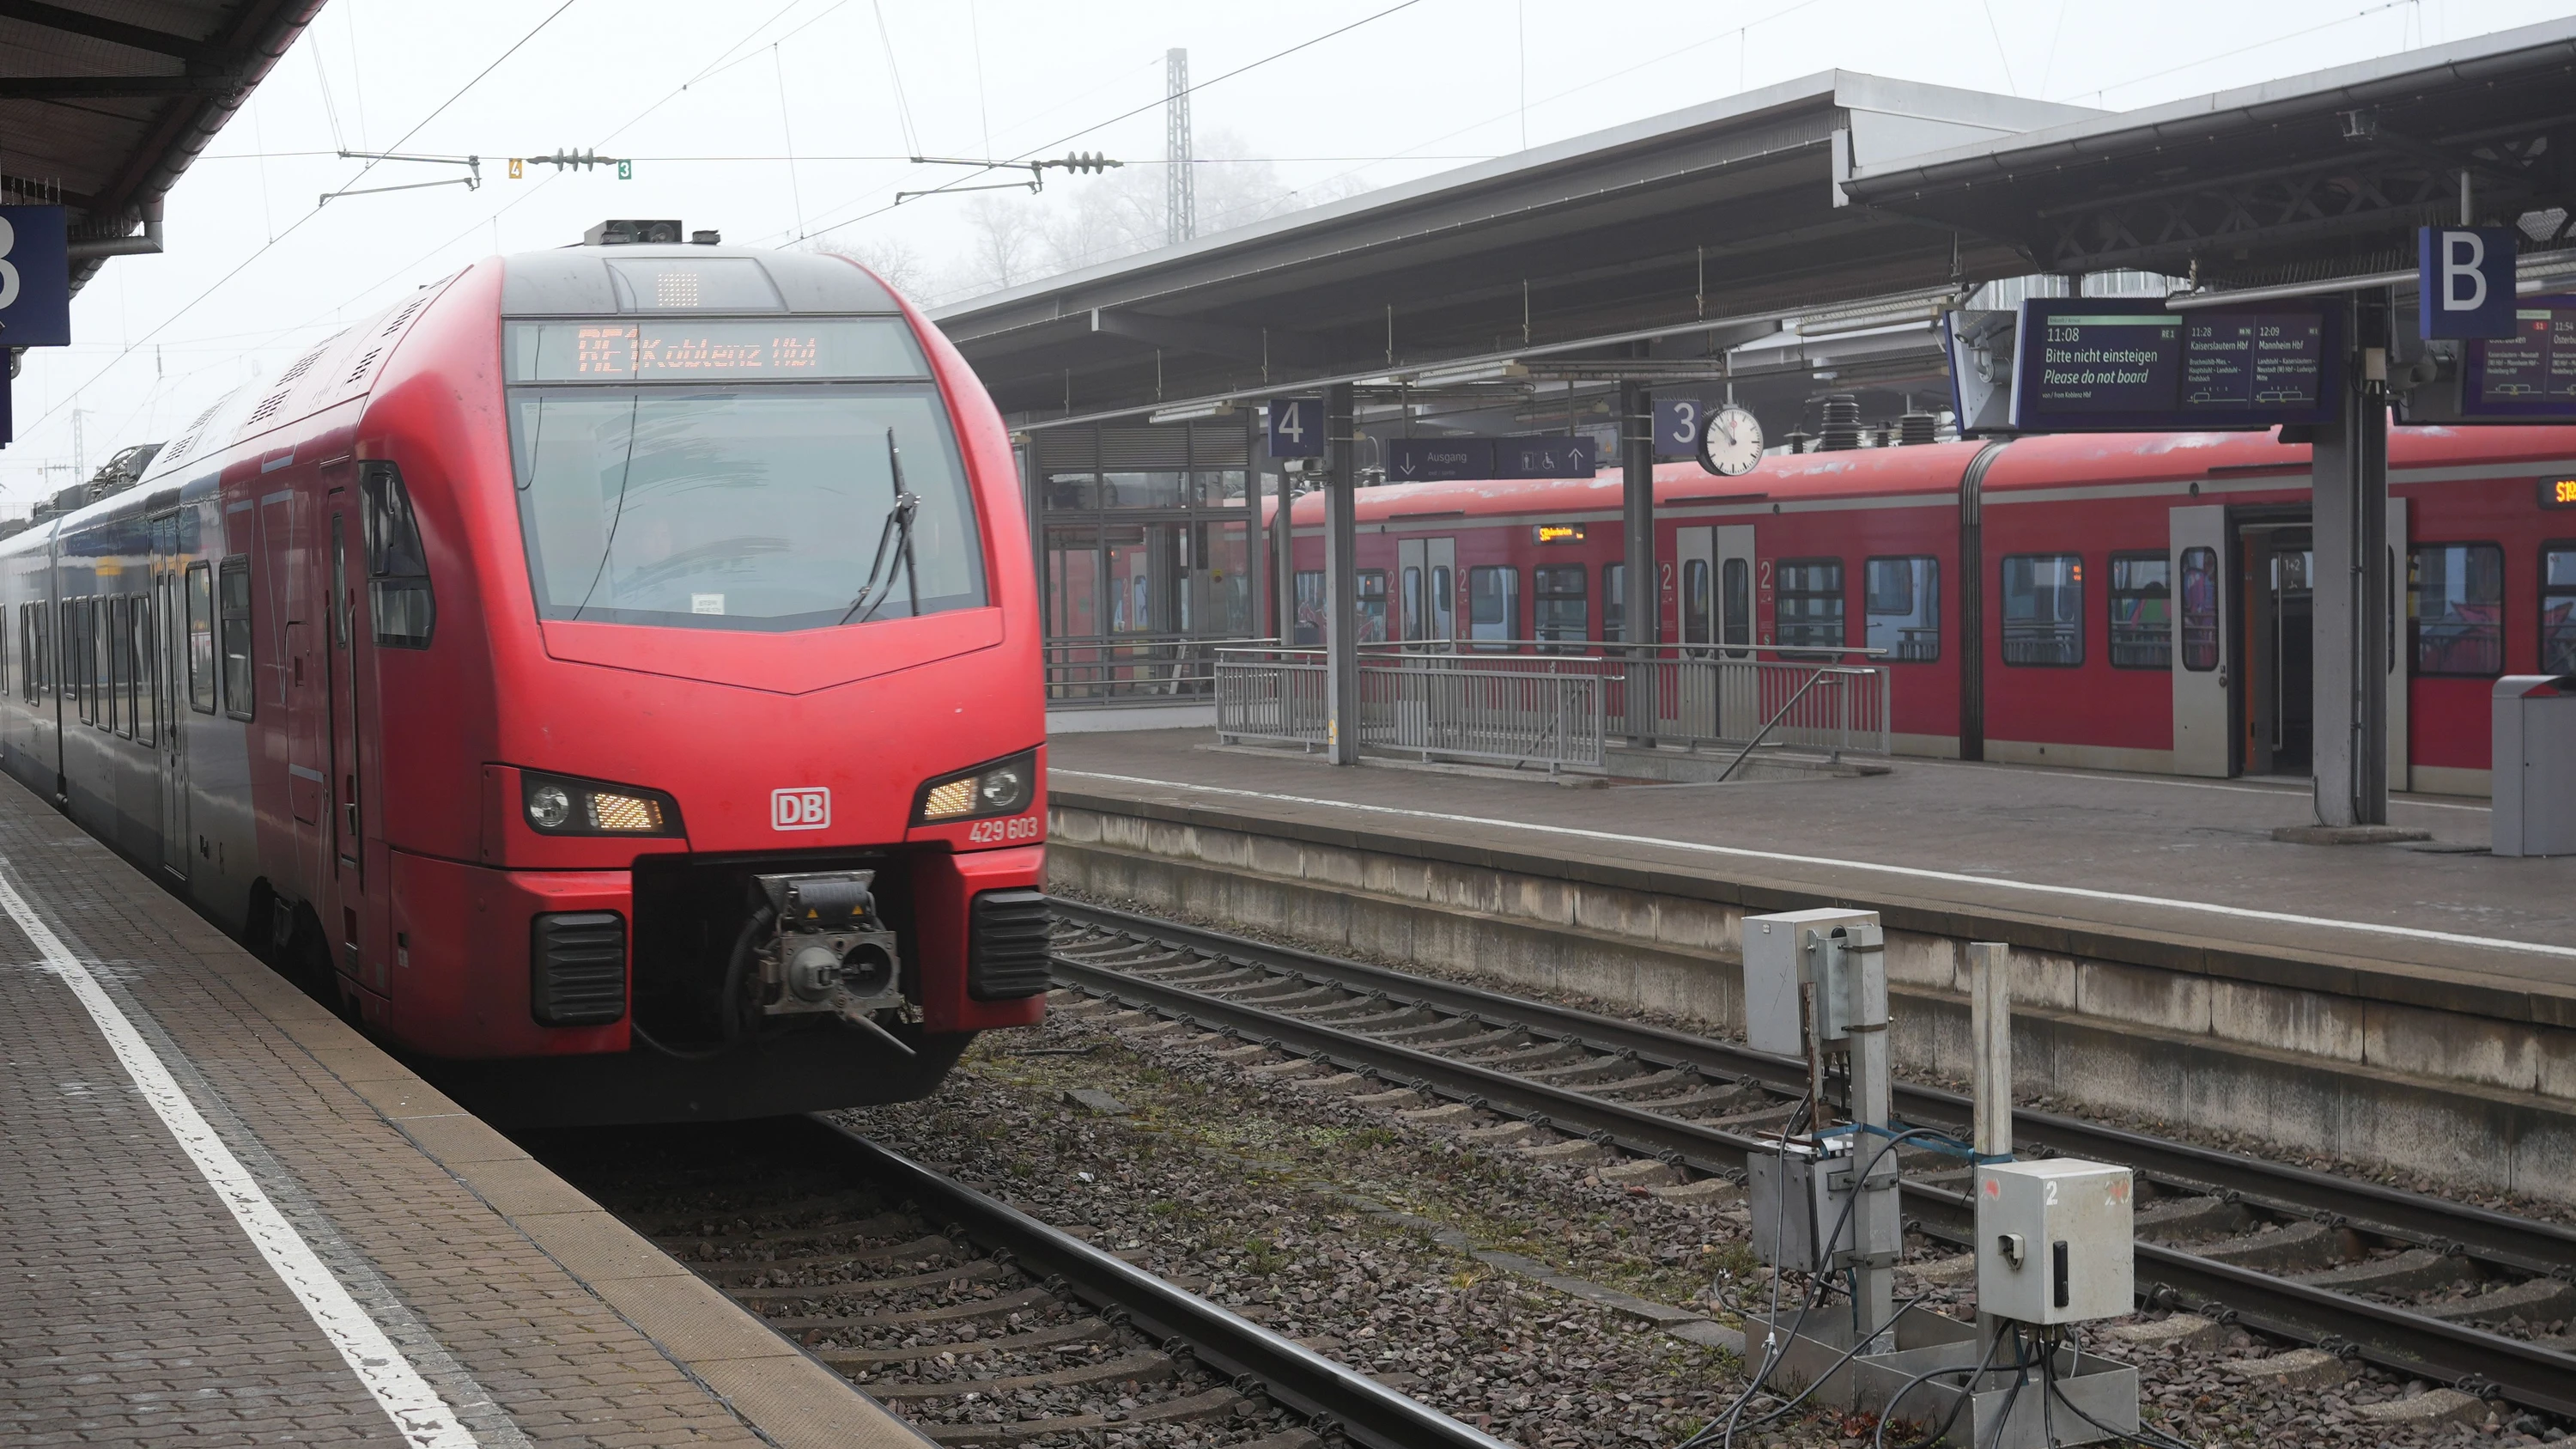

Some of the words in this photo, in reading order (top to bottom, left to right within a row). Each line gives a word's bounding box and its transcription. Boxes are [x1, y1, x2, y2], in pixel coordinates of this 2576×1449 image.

[511, 161, 520, 177] 4
[620, 161, 629, 177] 3
[2442, 231, 2487, 311] B
[2047, 327, 2080, 342] 11:08
[2161, 330, 2170, 338] RE
[2191, 326, 2212, 338] 11:28
[2259, 326, 2280, 338] 12:09
[2555, 322, 2574, 331] 11:54
[2190, 340, 2236, 350] Kaiserslautern
[2236, 340, 2249, 350] Hbf
[2258, 340, 2291, 350] Mannheim
[2292, 340, 2304, 350] Hbf
[2045, 348, 2072, 363] Bitte
[2074, 348, 2101, 363] nicht
[2103, 349, 2158, 366] einsteigen
[2044, 368, 2080, 384] Please
[2081, 369, 2095, 384] do
[2097, 370, 2116, 384] not
[2117, 368, 2149, 384] board
[1279, 402, 1303, 442] 4
[1673, 402, 1696, 443] 3
[1427, 452, 1467, 464] Ausgang
[1388, 570, 1394, 594] 2
[1460, 569, 1467, 592] 2
[1662, 563, 1672, 590] 2
[1761, 561, 1771, 589] 2
[779, 794, 824, 824] DB
[969, 821, 1004, 843] 429
[1007, 817, 1037, 838] 603
[2046, 1180, 2058, 1206] 2
